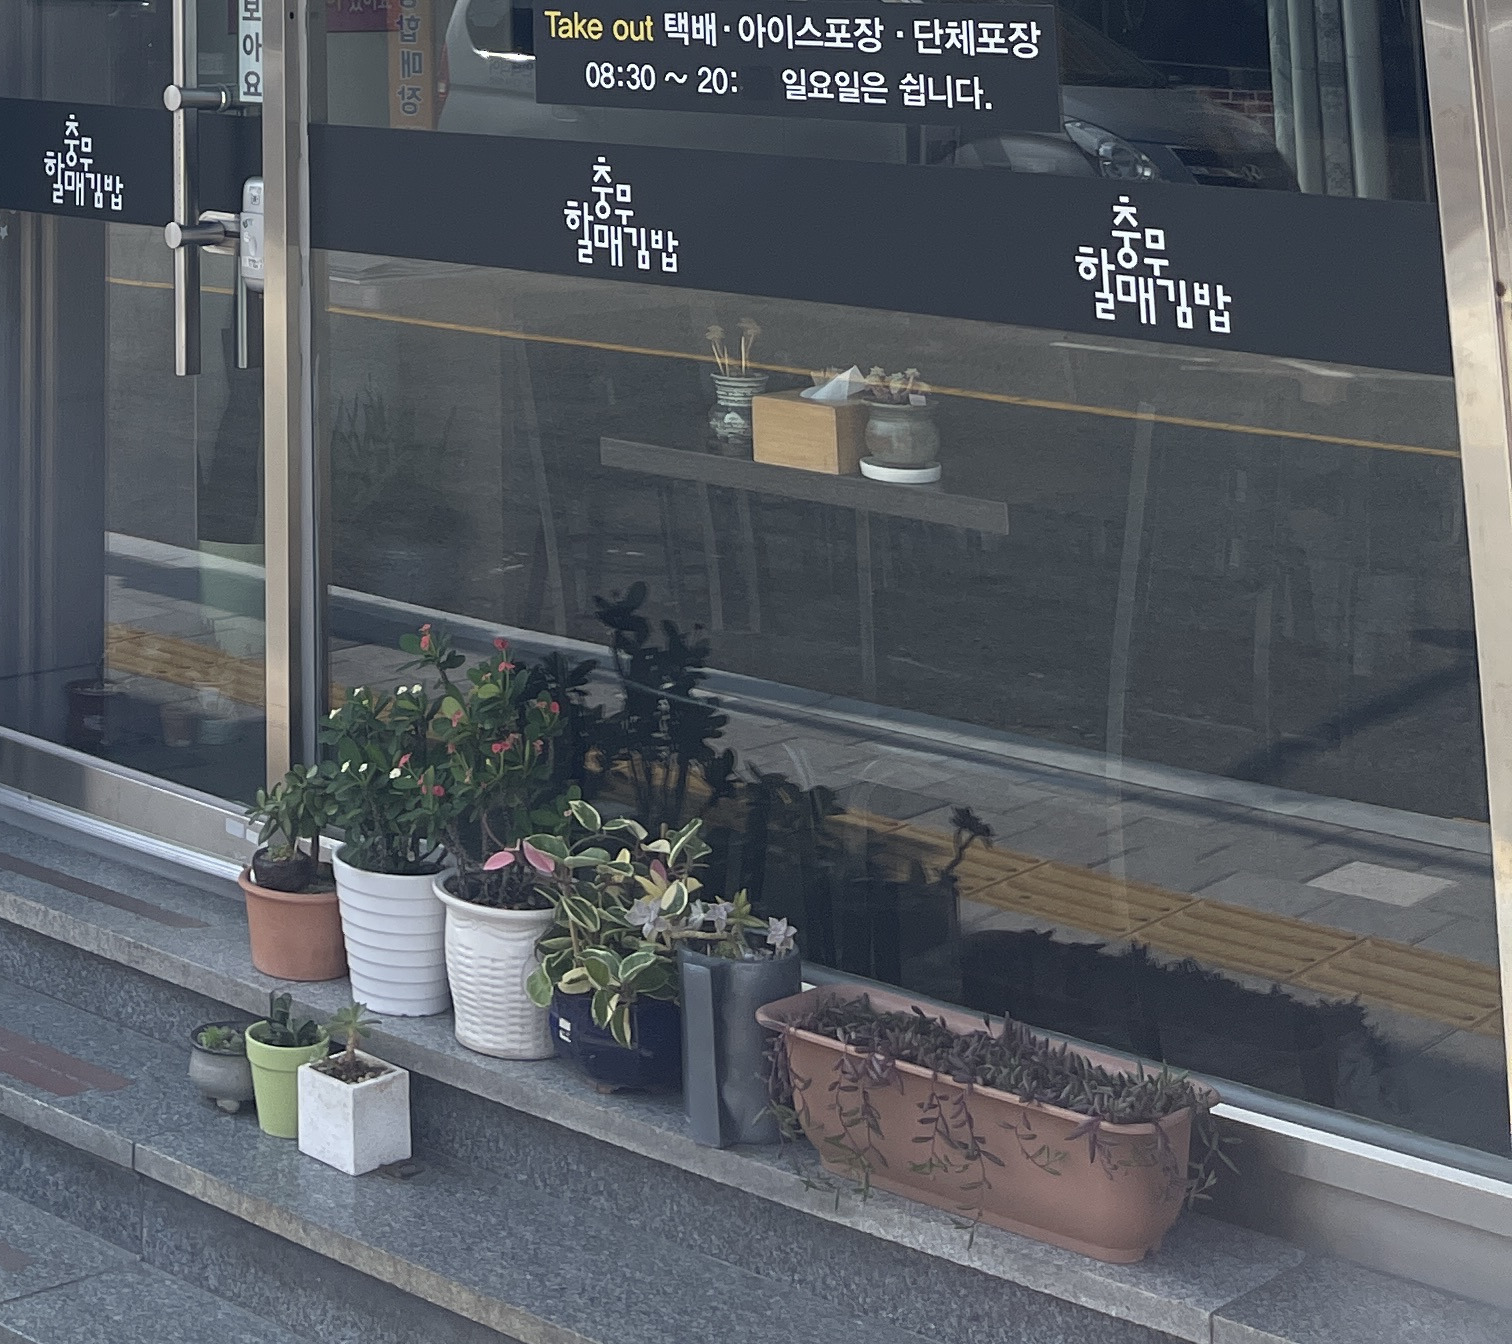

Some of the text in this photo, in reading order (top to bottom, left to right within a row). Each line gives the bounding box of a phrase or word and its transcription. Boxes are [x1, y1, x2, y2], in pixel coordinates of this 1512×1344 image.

[545, 11, 1040, 59] Take out 택배 아이스포장 단체포장
[585, 62, 655, 90] 08:30
[781, 69, 888, 104] 일요일은
[898, 73, 993, 110] 쉽니다.
[64, 114, 94, 172] 충무
[44, 150, 125, 211] 할매김밥
[591, 157, 635, 228] 충무
[563, 198, 678, 275] 할매김밥
[1110, 197, 1166, 279] 충무
[1075, 245, 1232, 335] 할매김밥
